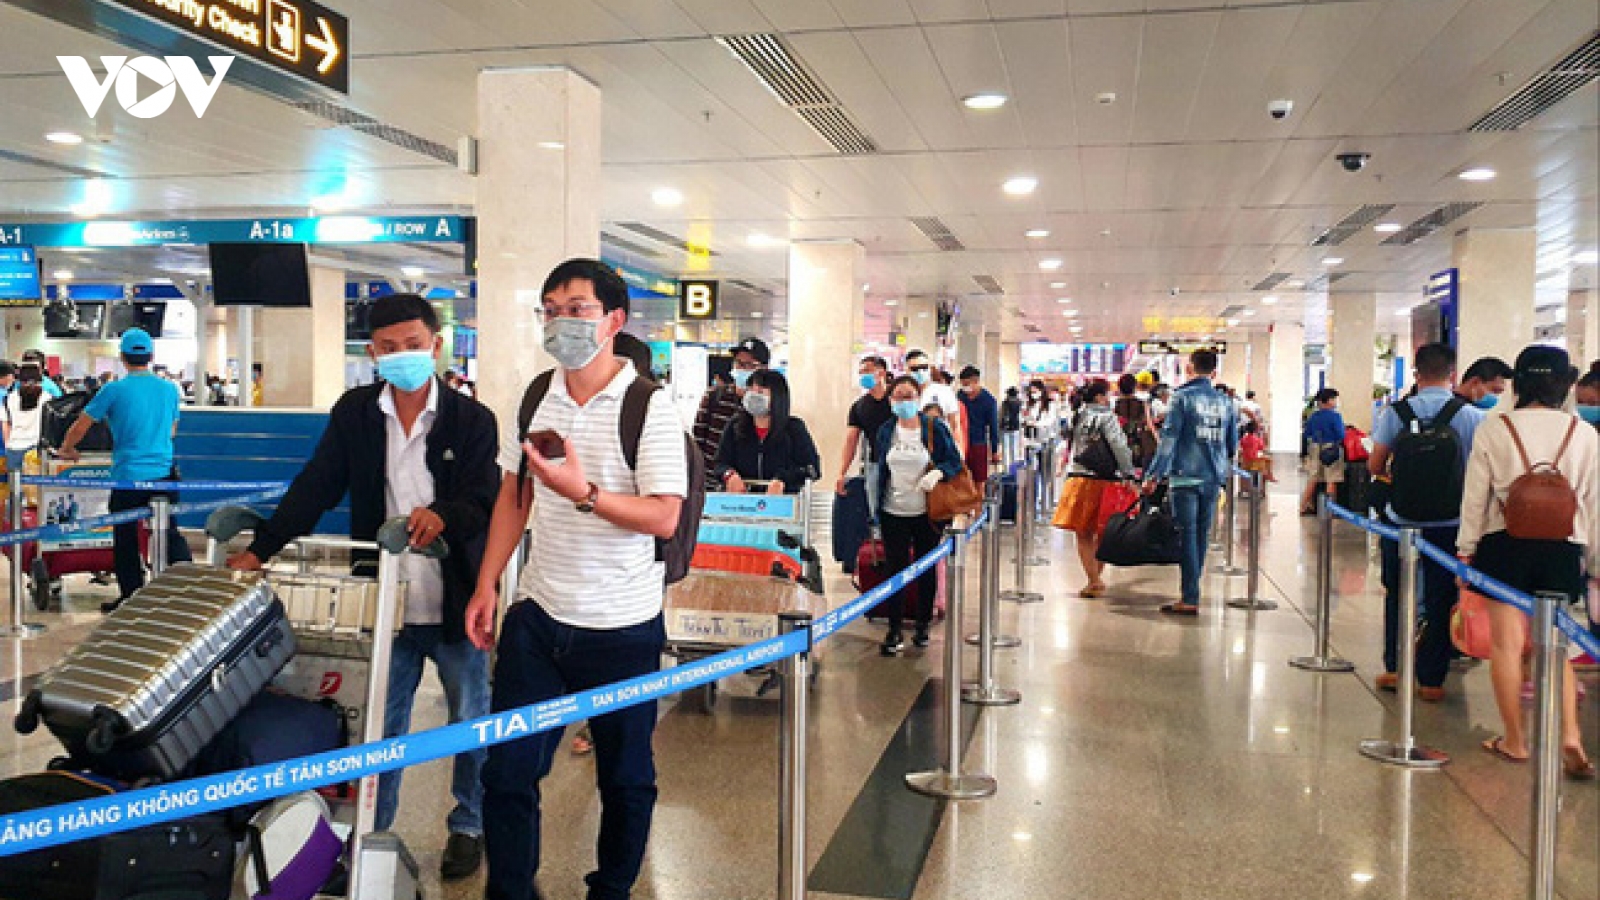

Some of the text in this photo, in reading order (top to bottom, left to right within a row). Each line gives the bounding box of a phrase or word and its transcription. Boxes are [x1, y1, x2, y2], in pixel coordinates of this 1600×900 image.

[208, 4, 260, 47] Check
[249, 220, 294, 240] A-1a
[396, 223, 427, 235] ROW
[434, 217, 451, 237] A
[686, 284, 713, 316] B
[671, 654, 744, 687] INTERNATIONAL
[746, 641, 784, 661] AIRPORT
[472, 713, 528, 743] TIA
[58, 807, 122, 833] HÀNG
[127, 788, 199, 819] KHÔNG
